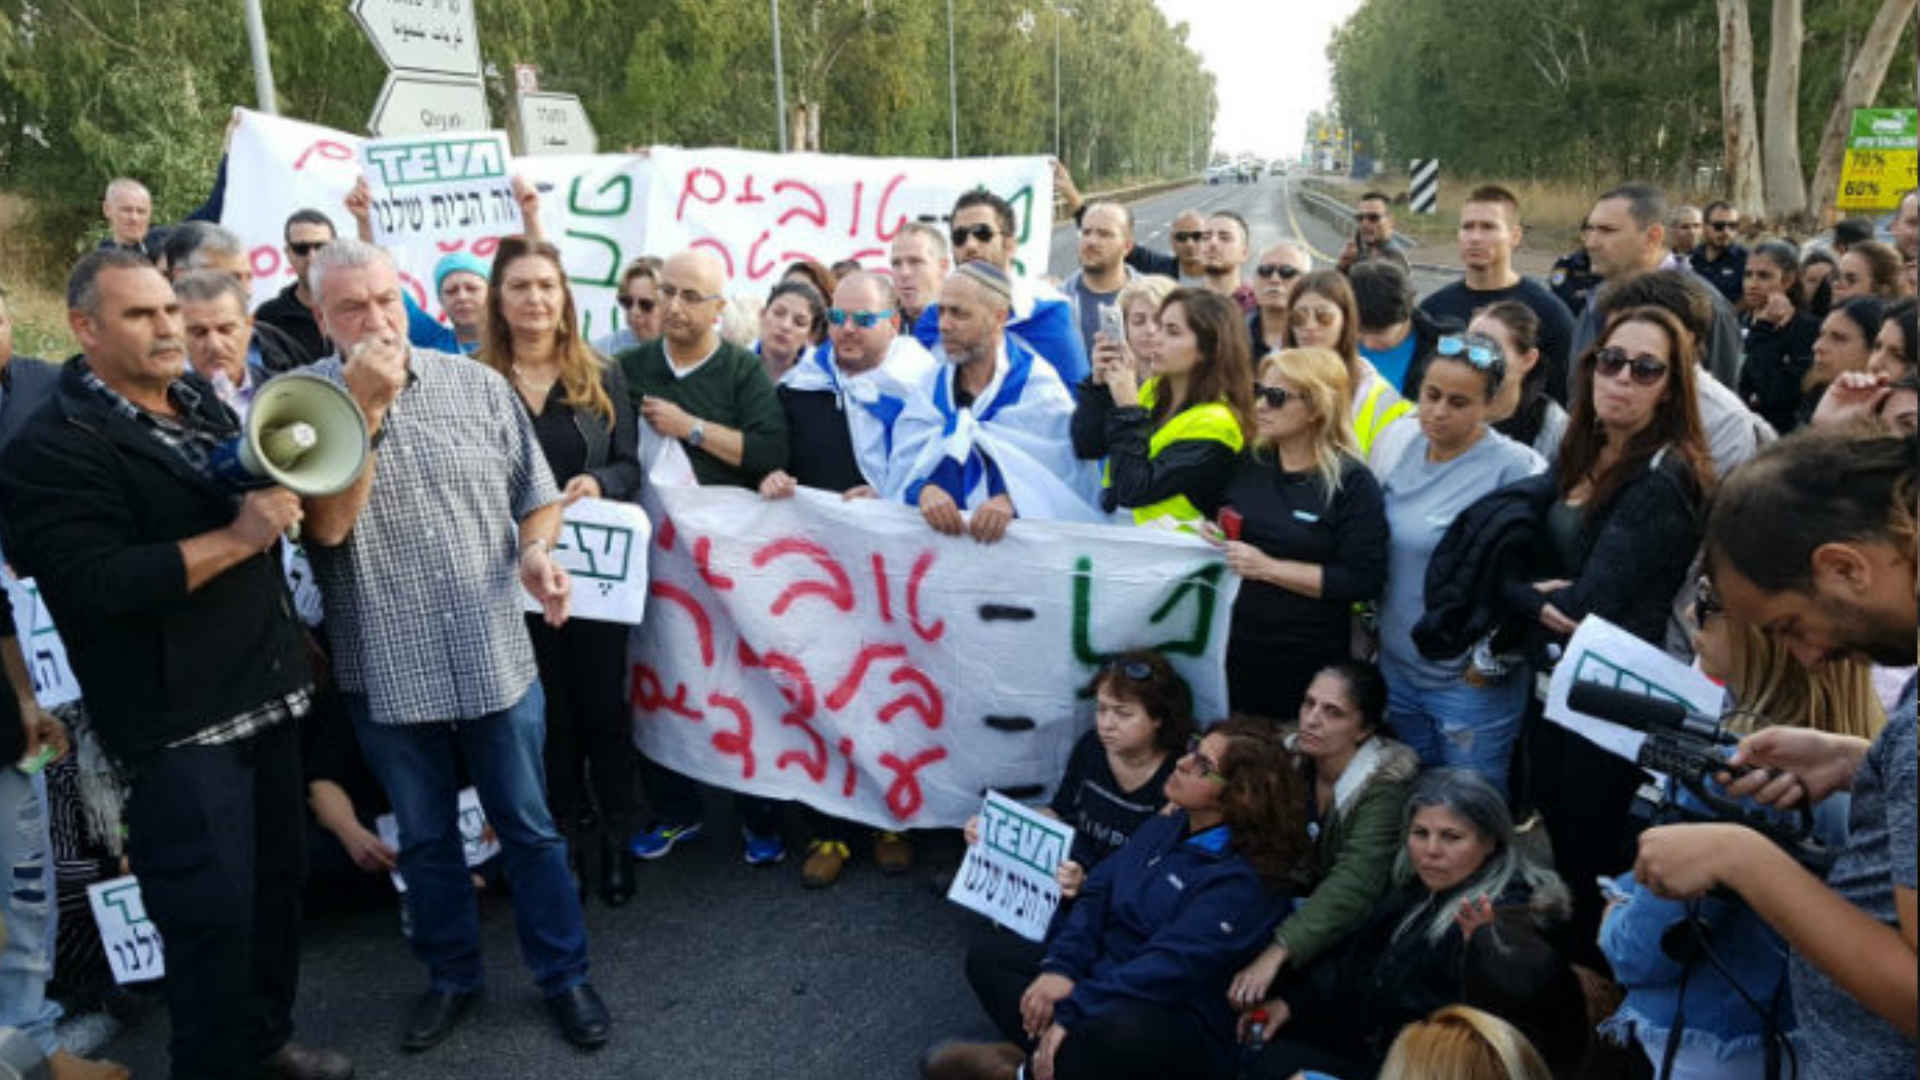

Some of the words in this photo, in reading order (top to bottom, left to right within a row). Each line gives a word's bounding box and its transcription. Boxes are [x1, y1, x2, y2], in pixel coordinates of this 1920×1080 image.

[366, 139, 506, 187] TEVA
[372, 187, 424, 233] שלנו
[430, 191, 486, 229] הבית
[656, 514, 945, 643] טובי
[631, 662, 949, 820] עובדים
[985, 799, 1065, 877] TEVA
[113, 926, 163, 973] לנו
